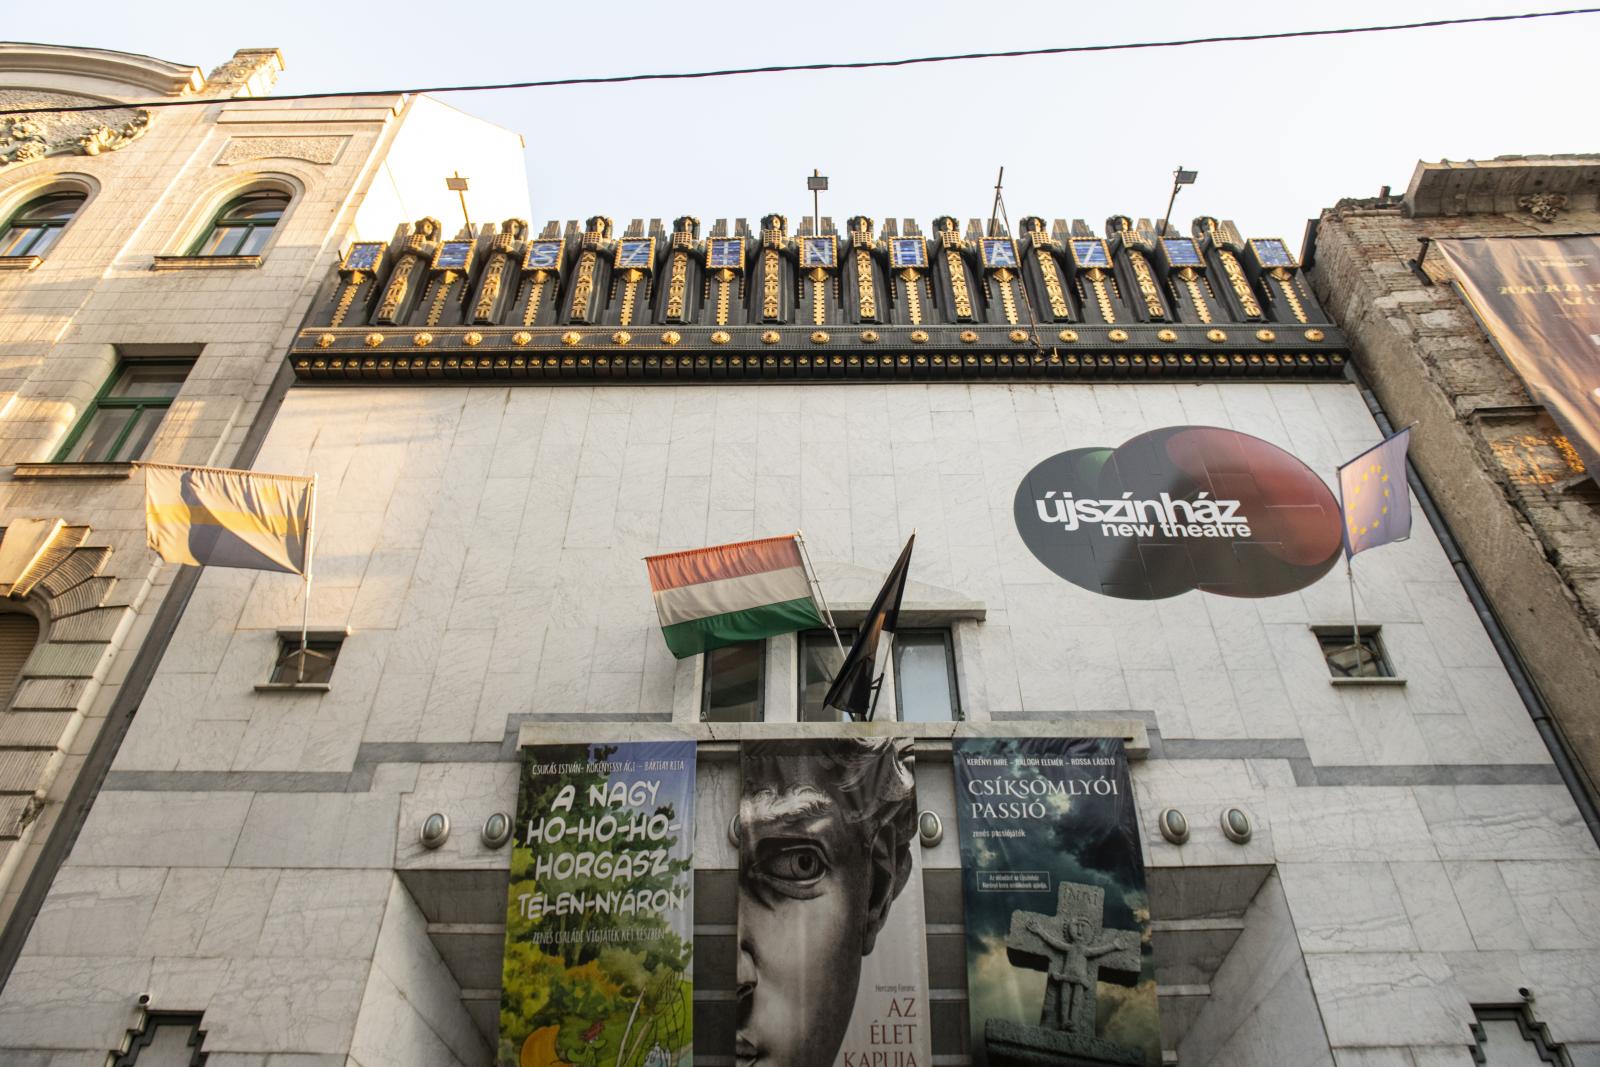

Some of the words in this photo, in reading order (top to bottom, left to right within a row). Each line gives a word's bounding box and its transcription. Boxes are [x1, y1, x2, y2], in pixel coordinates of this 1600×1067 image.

[1036, 491, 1247, 531] újszínház
[1102, 523, 1154, 537] new
[1160, 521, 1252, 538] theatre
[532, 762, 557, 775] CSUKÁS
[1071, 758, 1091, 766] ROSSA
[551, 784, 576, 812] A
[589, 780, 661, 808] NAGY
[968, 775, 1118, 799] CSÍKSOMLYÓI
[971, 798, 1046, 819] PASSIÓ
[526, 813, 681, 845] HO-HO-HO-
[535, 847, 669, 882] HORGÁSZ
[518, 887, 685, 920] TÉLEN-NYÁRON
[888, 997, 917, 1018] AZ
[870, 1019, 918, 1045] ÉLET
